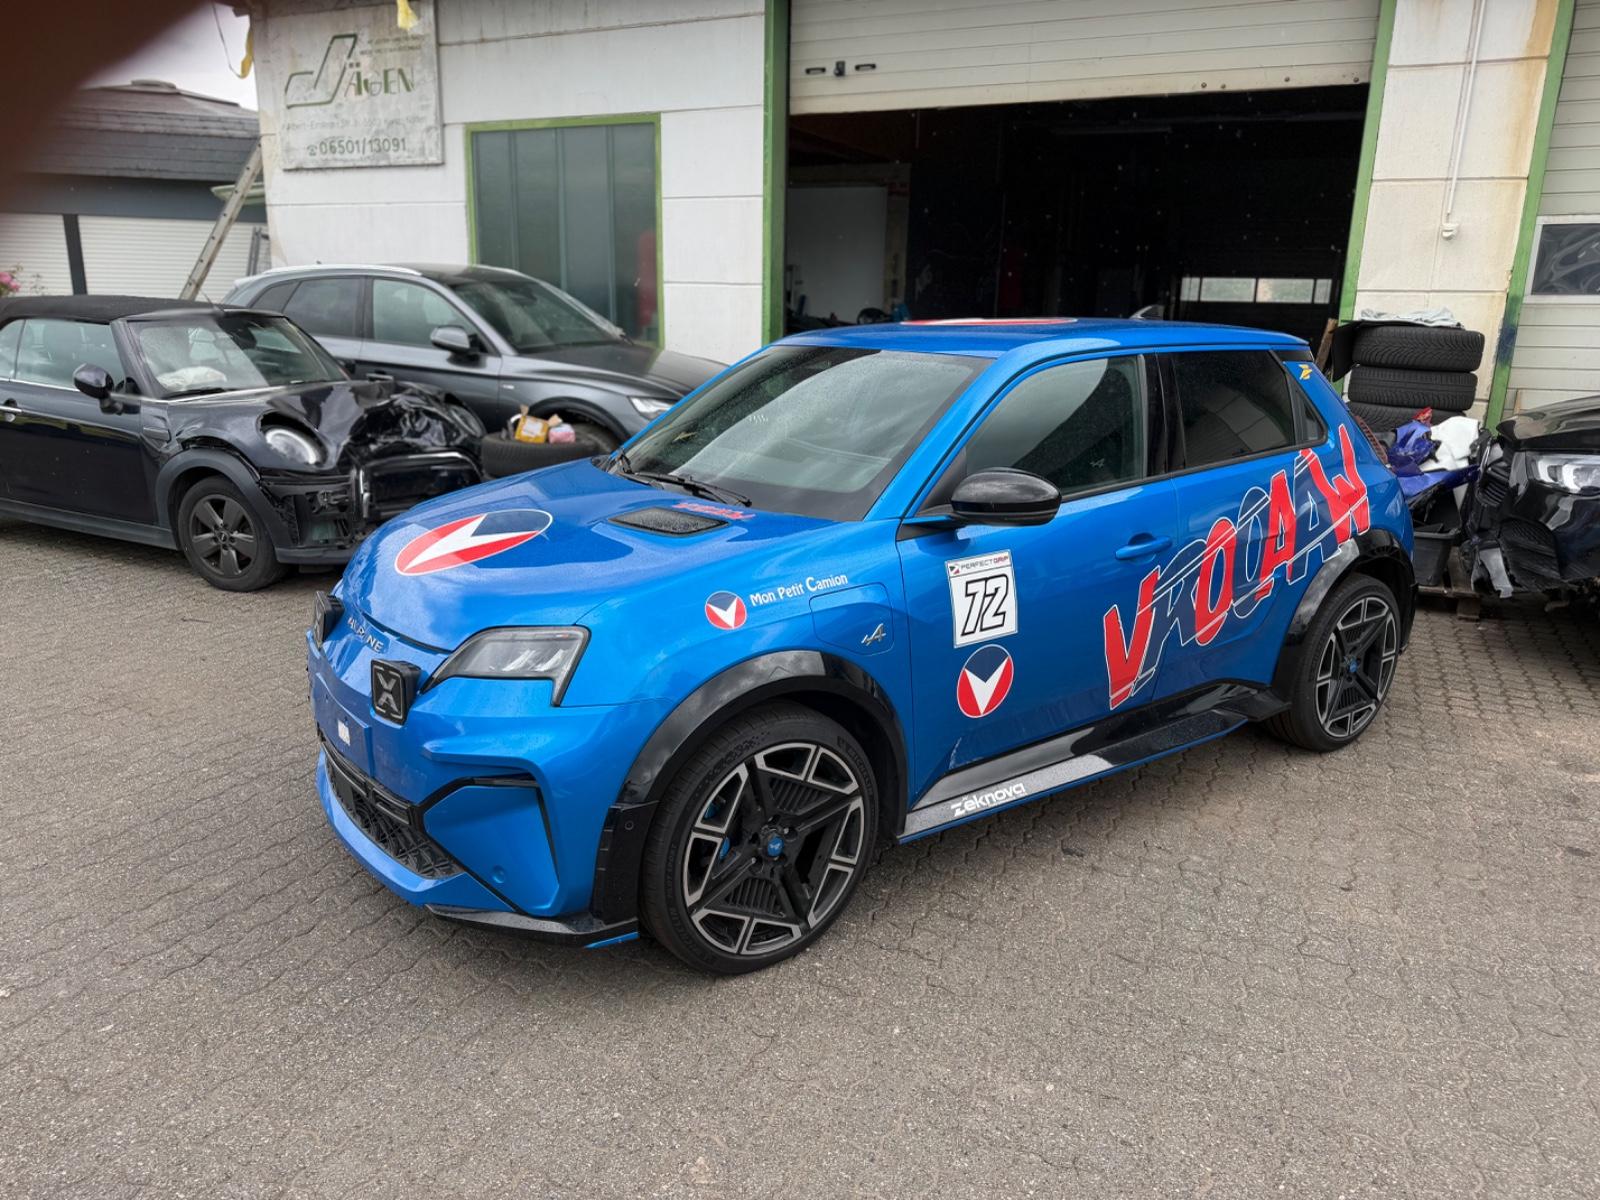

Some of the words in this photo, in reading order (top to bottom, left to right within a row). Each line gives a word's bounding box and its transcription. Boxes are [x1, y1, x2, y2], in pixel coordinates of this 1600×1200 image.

[319, 137, 406, 156] 06501/13091
[749, 592, 777, 607] Mon
[777, 582, 805, 600] Petit
[805, 574, 848, 592] Camion
[960, 573, 1009, 637] 72
